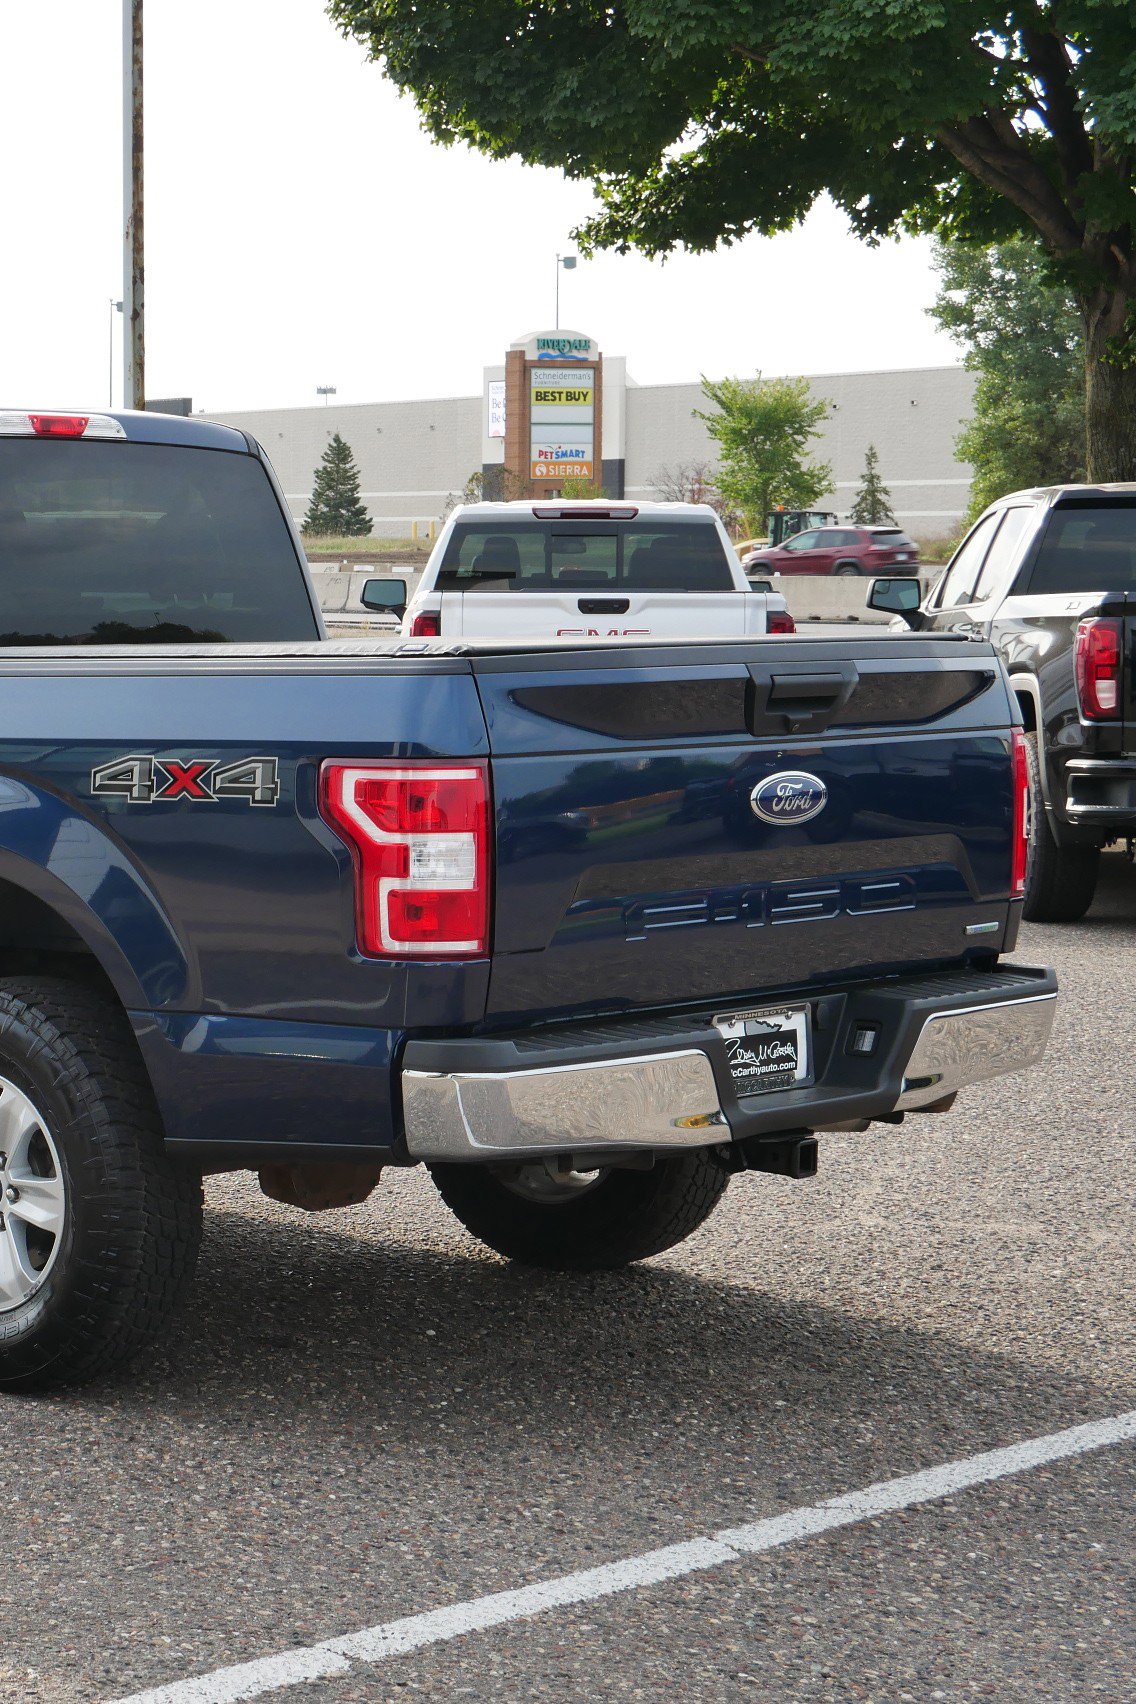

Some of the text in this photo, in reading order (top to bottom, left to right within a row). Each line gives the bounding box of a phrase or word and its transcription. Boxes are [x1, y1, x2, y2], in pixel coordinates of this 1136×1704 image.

[536, 338, 591, 354] RIVERDALE
[533, 371, 591, 380] Schneiderman's
[535, 391, 589, 402] BEST BUY
[538, 449, 586, 460] PETSMART
[548, 465, 589, 476] SIERRA
[772, 782, 813, 812] Ford
[734, 1008, 788, 1021] MINNESOTA
[731, 1061, 796, 1078] cCarthyauto.com
